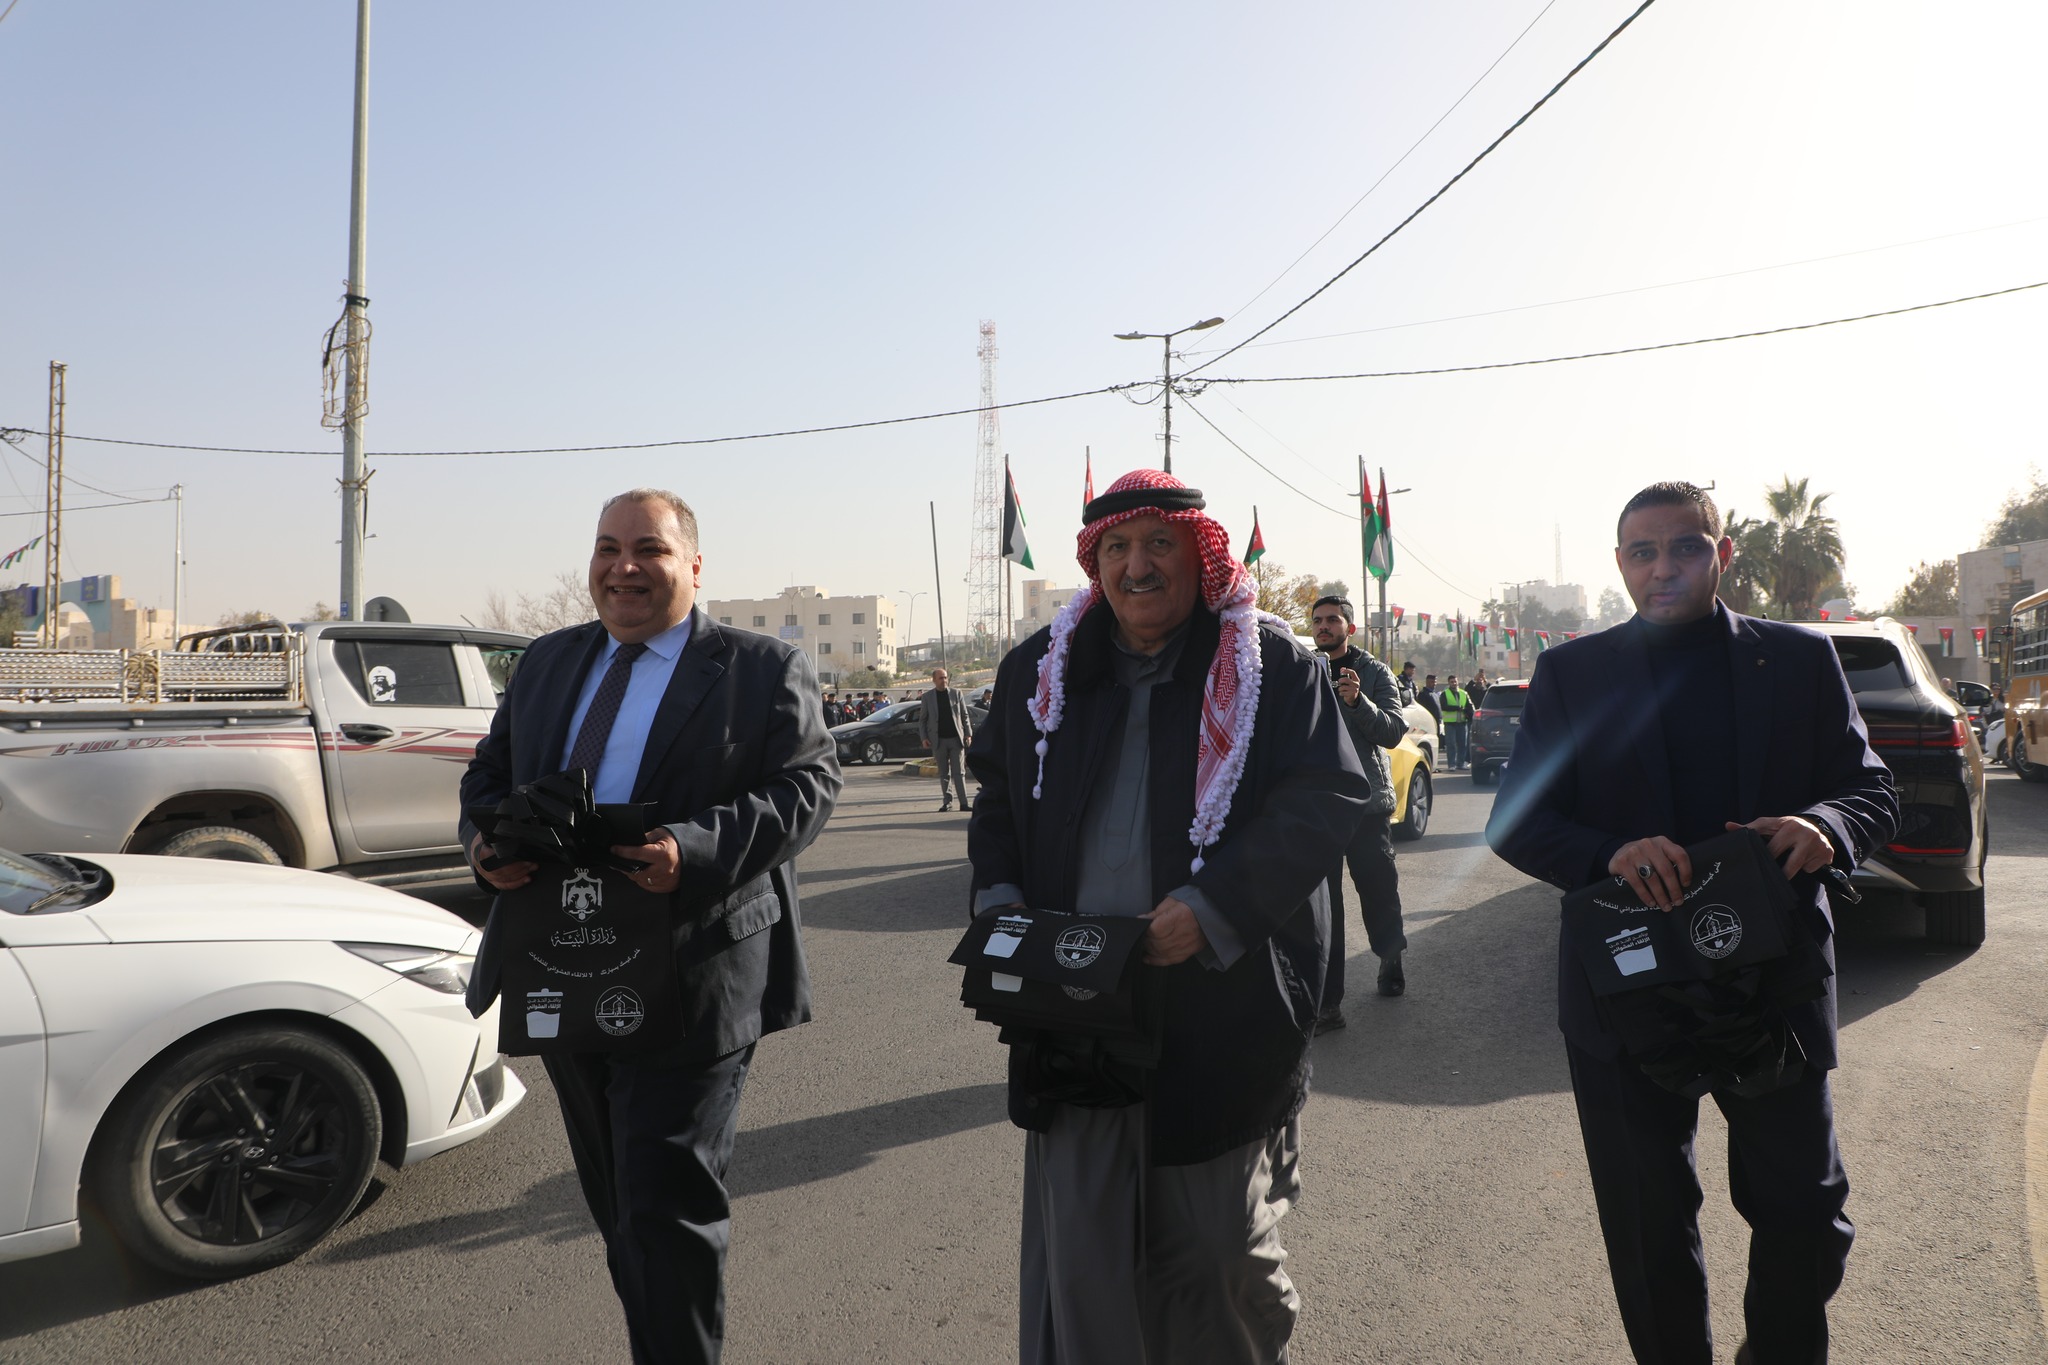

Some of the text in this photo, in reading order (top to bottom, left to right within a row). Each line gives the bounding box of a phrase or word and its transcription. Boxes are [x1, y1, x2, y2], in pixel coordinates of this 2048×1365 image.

[51, 736, 187, 757] HILUX
[551, 927, 617, 947] وزارة البيئة
